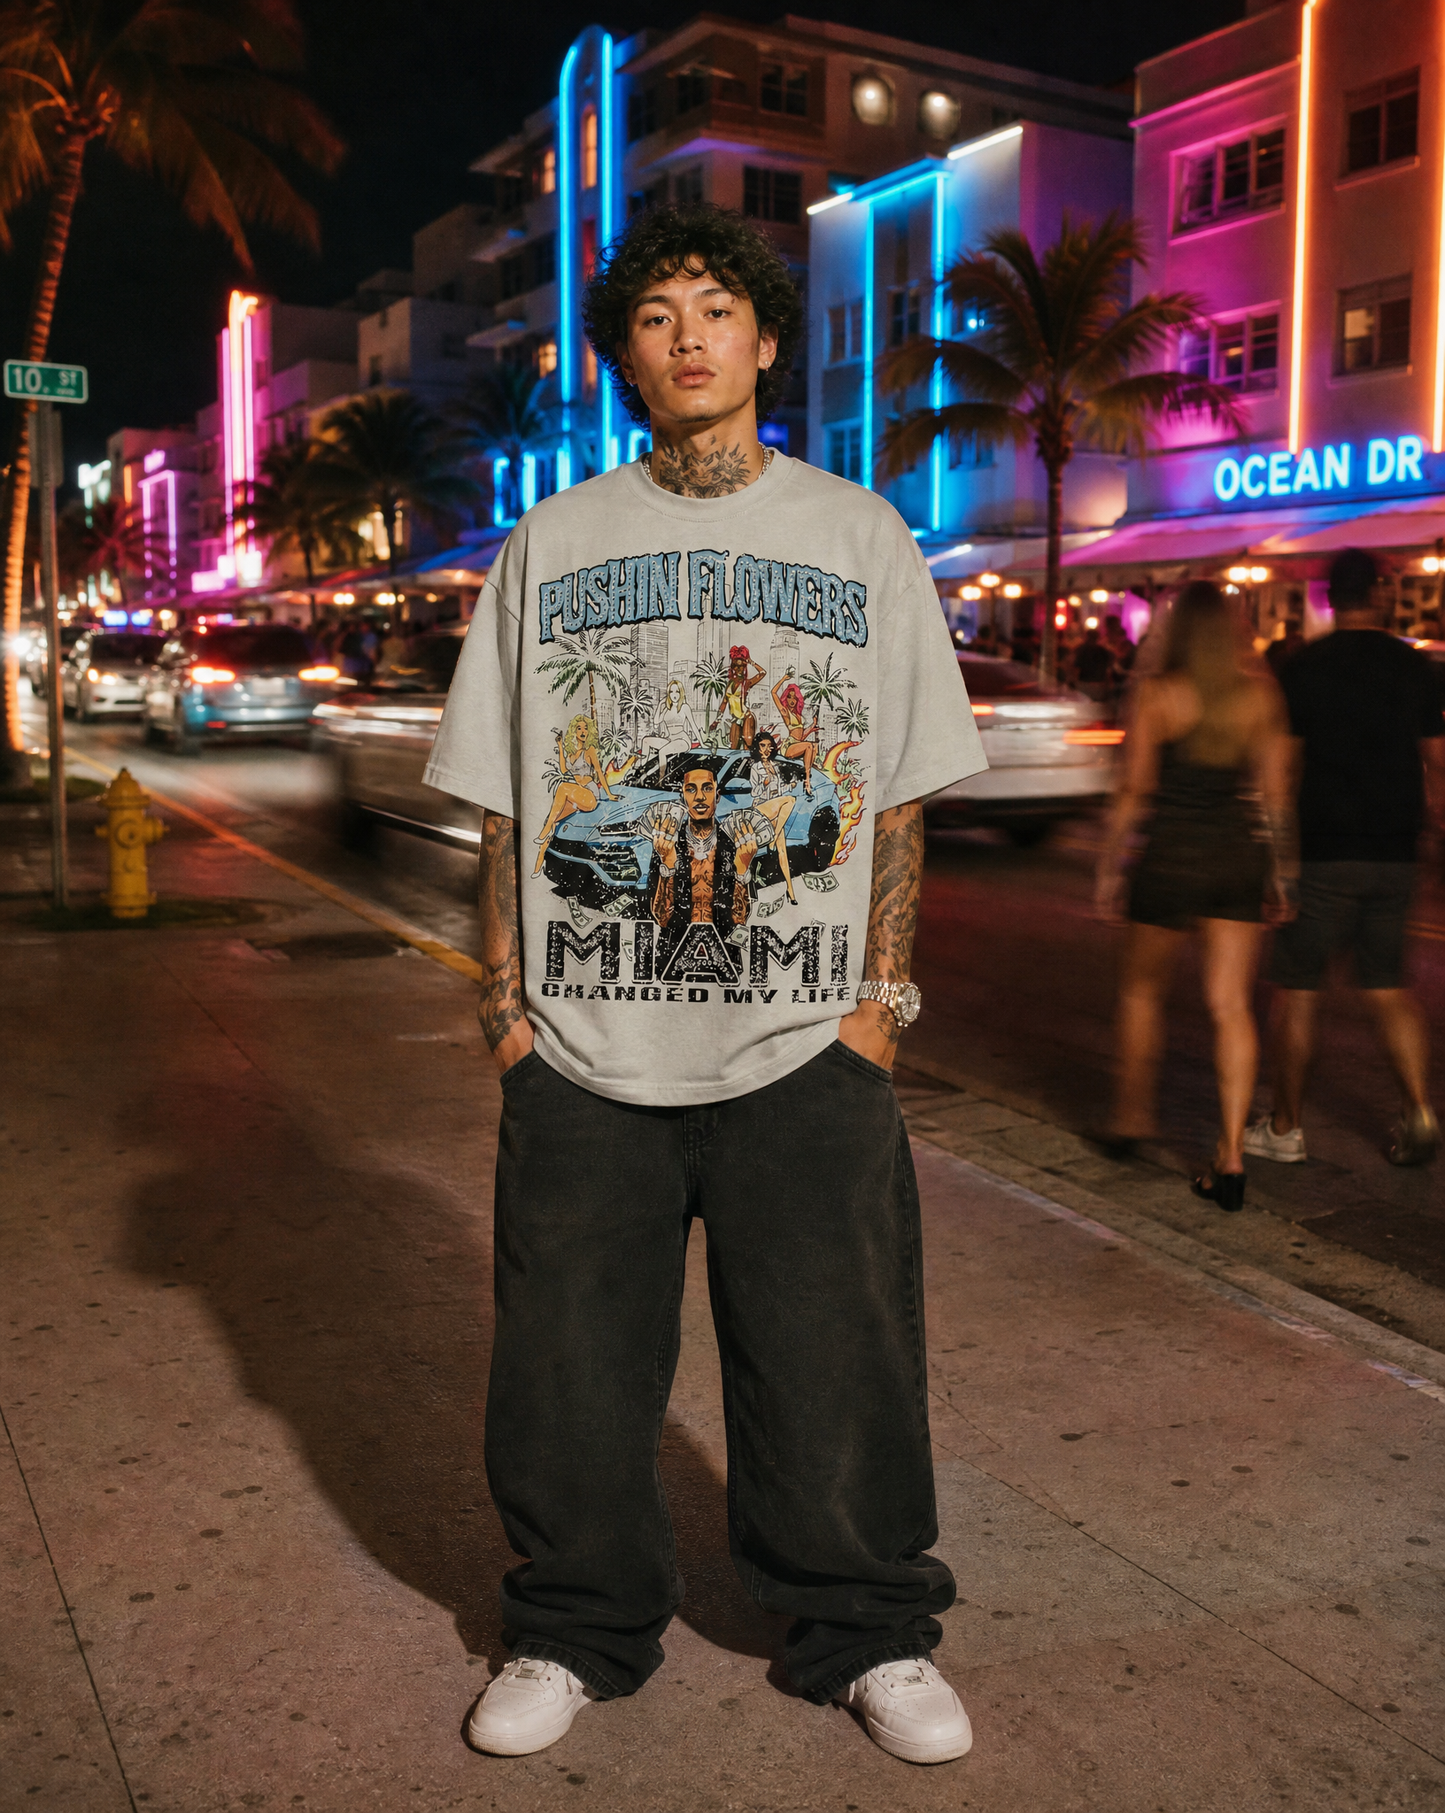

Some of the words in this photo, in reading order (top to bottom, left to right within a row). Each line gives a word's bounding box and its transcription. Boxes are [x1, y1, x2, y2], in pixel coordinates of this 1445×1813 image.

[13, 366, 42, 393] 10
[1213, 442, 1351, 502] OCEAN
[1366, 434, 1423, 486] DR
[539, 551, 682, 645] PUSHIN
[687, 549, 869, 648] FLOWERS
[544, 920, 850, 988] MIAMI
[541, 982, 709, 1003] CHANGED
[723, 988, 778, 1003] MY
[791, 986, 850, 1004] LIFE
